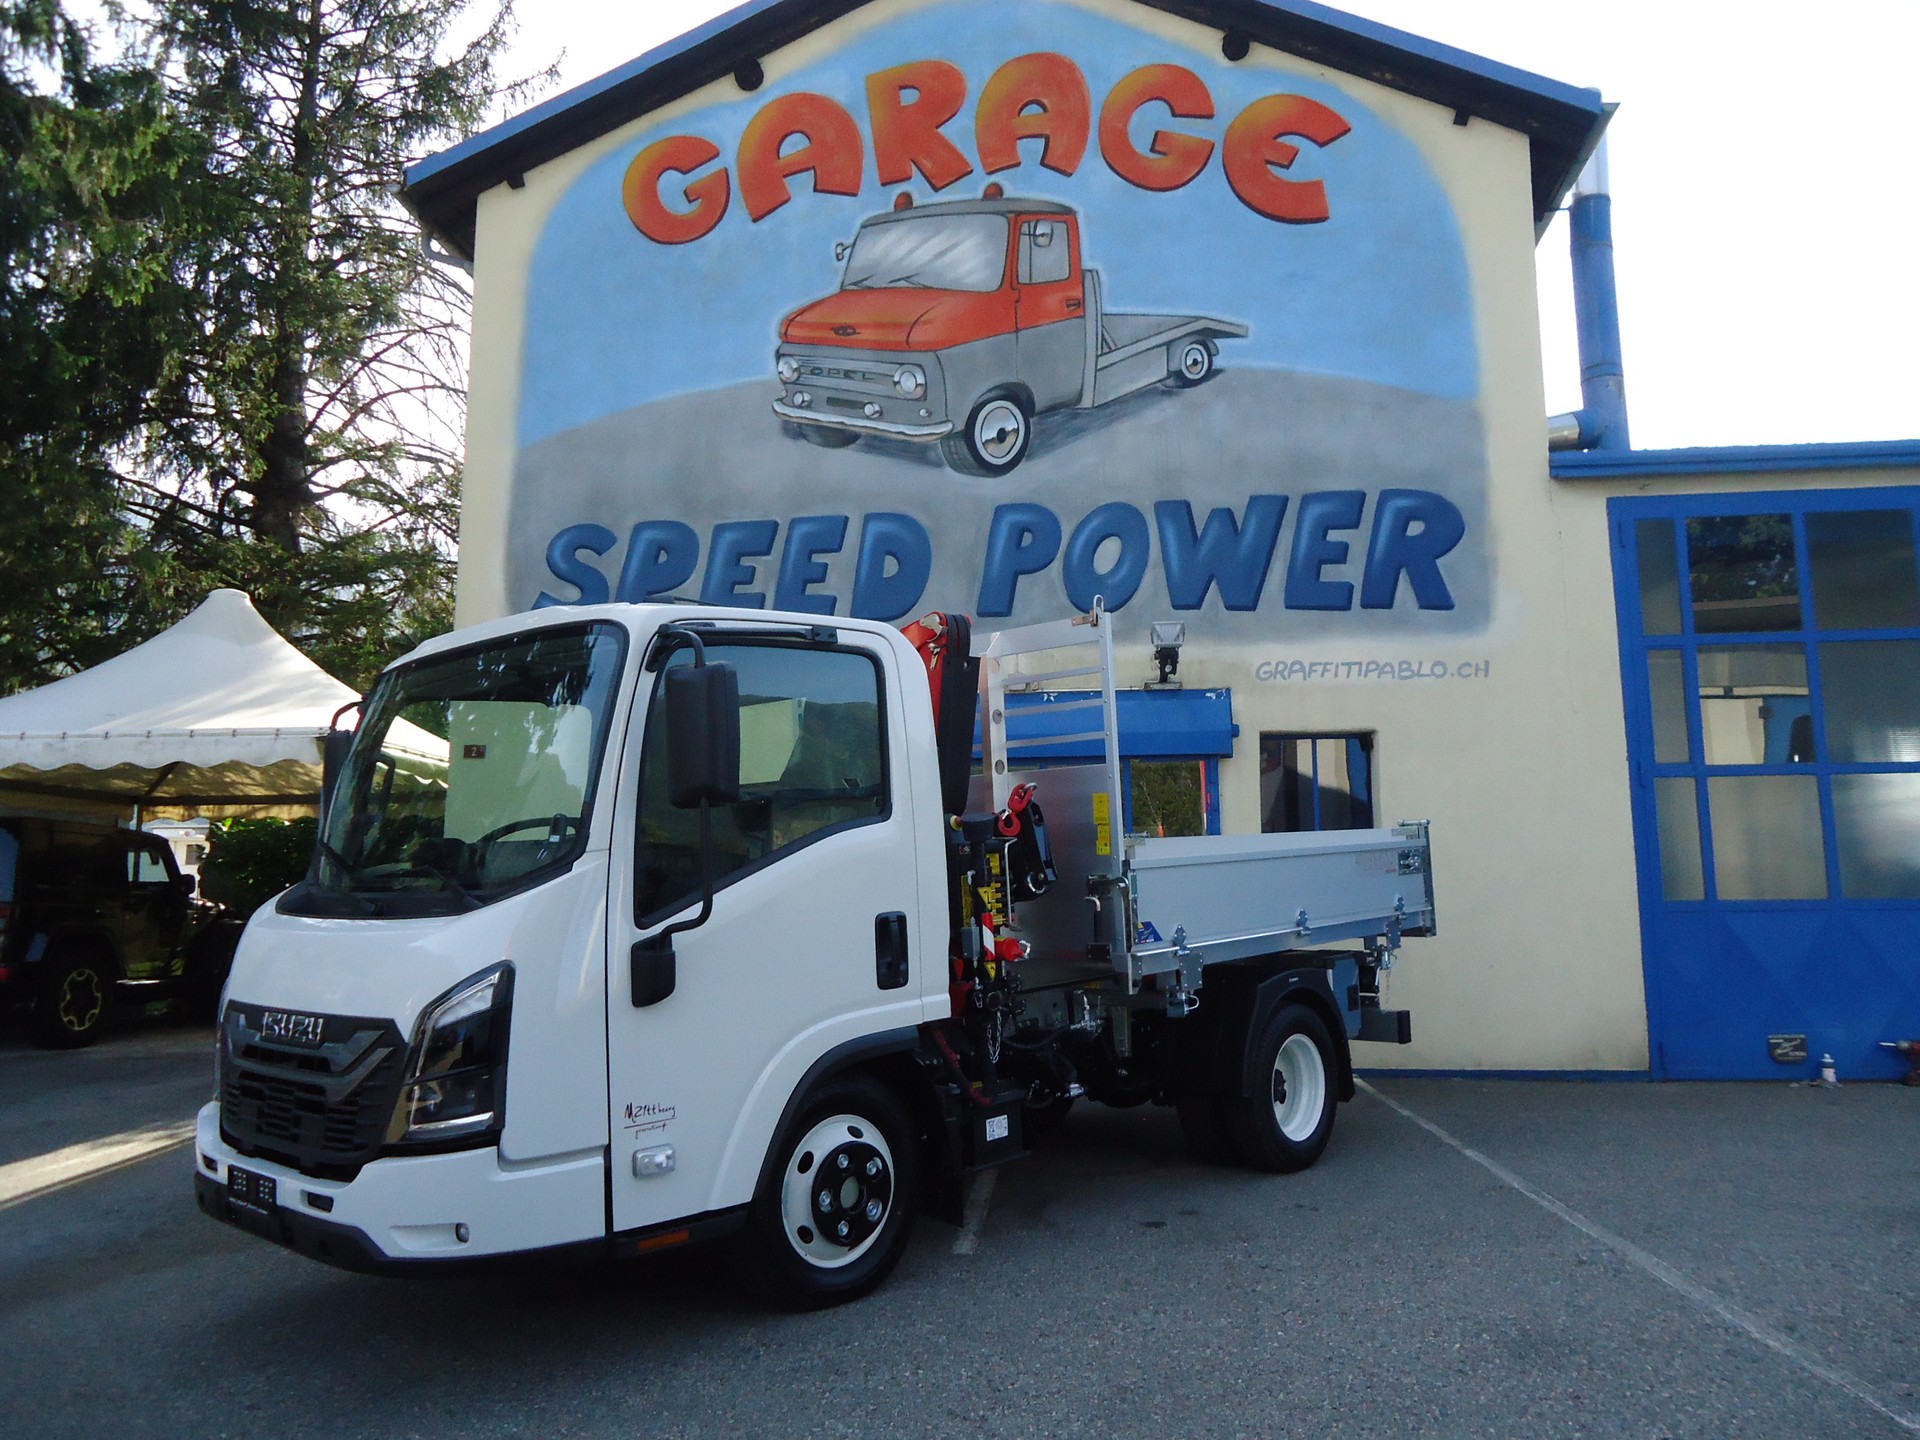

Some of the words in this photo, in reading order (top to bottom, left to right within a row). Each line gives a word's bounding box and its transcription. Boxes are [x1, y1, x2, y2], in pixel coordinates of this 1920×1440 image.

[623, 52, 1351, 244] GARAGE
[810, 366, 875, 380] OPEL
[531, 511, 931, 621] SPEED
[977, 489, 1467, 612] POWER
[1255, 660, 1490, 682] GRAFFITIPABLO.CH
[262, 1011, 324, 1042] ISUZU
